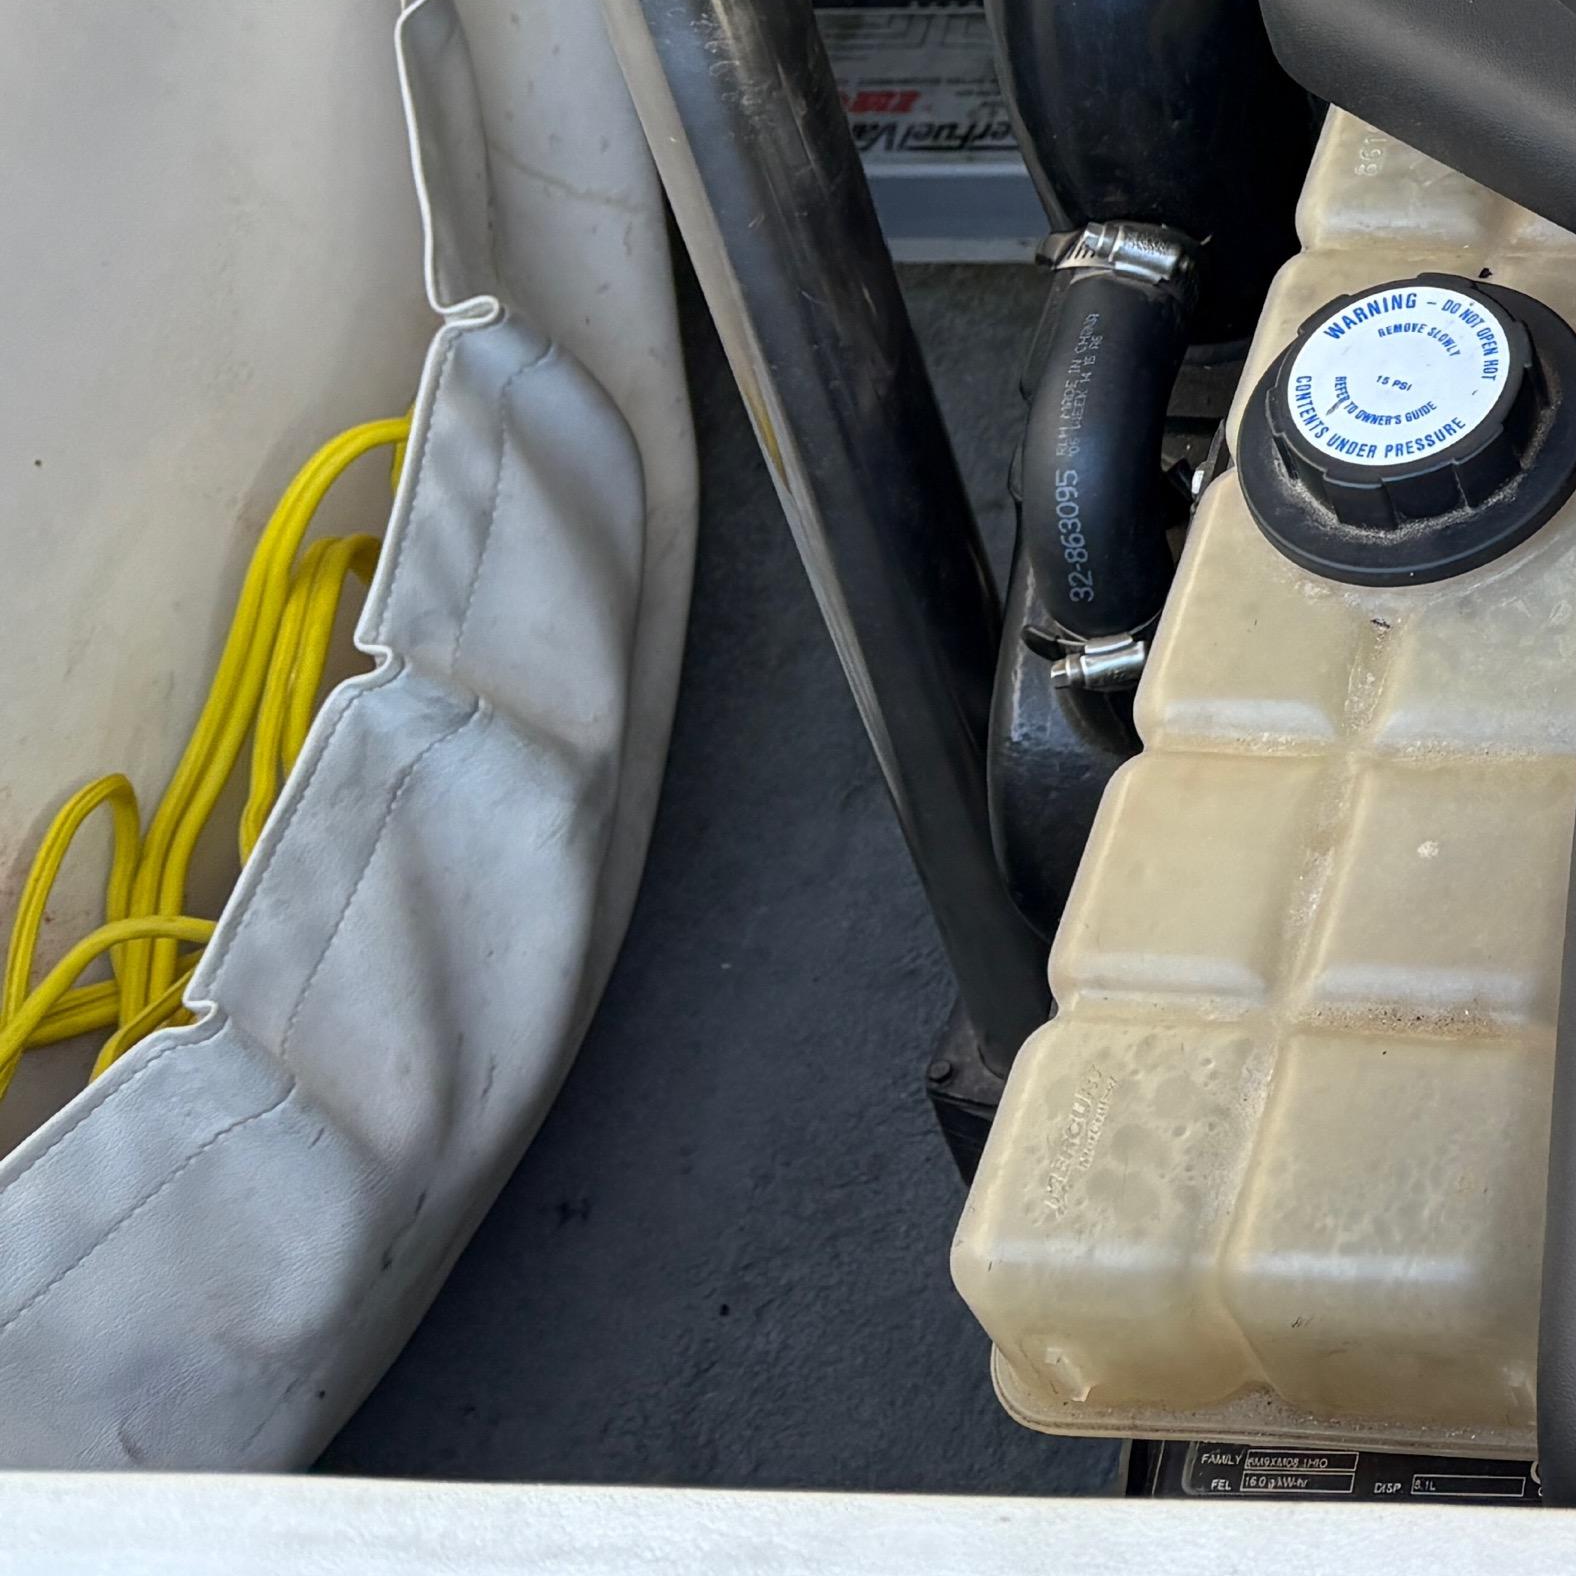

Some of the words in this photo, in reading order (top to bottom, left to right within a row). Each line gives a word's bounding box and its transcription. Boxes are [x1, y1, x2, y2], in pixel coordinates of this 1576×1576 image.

[1323, 293, 1418, 341] WARNING
[1441, 299, 1461, 315] DO
[1459, 307, 1485, 333] NOT
[1378, 323, 1426, 337] REMOVE
[1427, 326, 1460, 358] SLOWLY
[1476, 325, 1499, 357] OPEN
[1376, 375, 1391, 387] 15
[1391, 379, 1412, 392] PSI
[1481, 359, 1499, 382] HOT
[1335, 375, 1351, 403] REFER
[1344, 400, 1357, 415] TO
[1356, 408, 1401, 425] OWNER'S
[1405, 401, 1437, 423] GUIDE
[1296, 375, 1329, 439] CONTENTS
[1327, 435, 1378, 459] UNDER
[1384, 417, 1466, 458] PRESSURE
[1056, 470, 1094, 602] 32-863095
[1201, 1454, 1243, 1465] FAMILY
[1211, 1479, 1232, 1490] FEL
